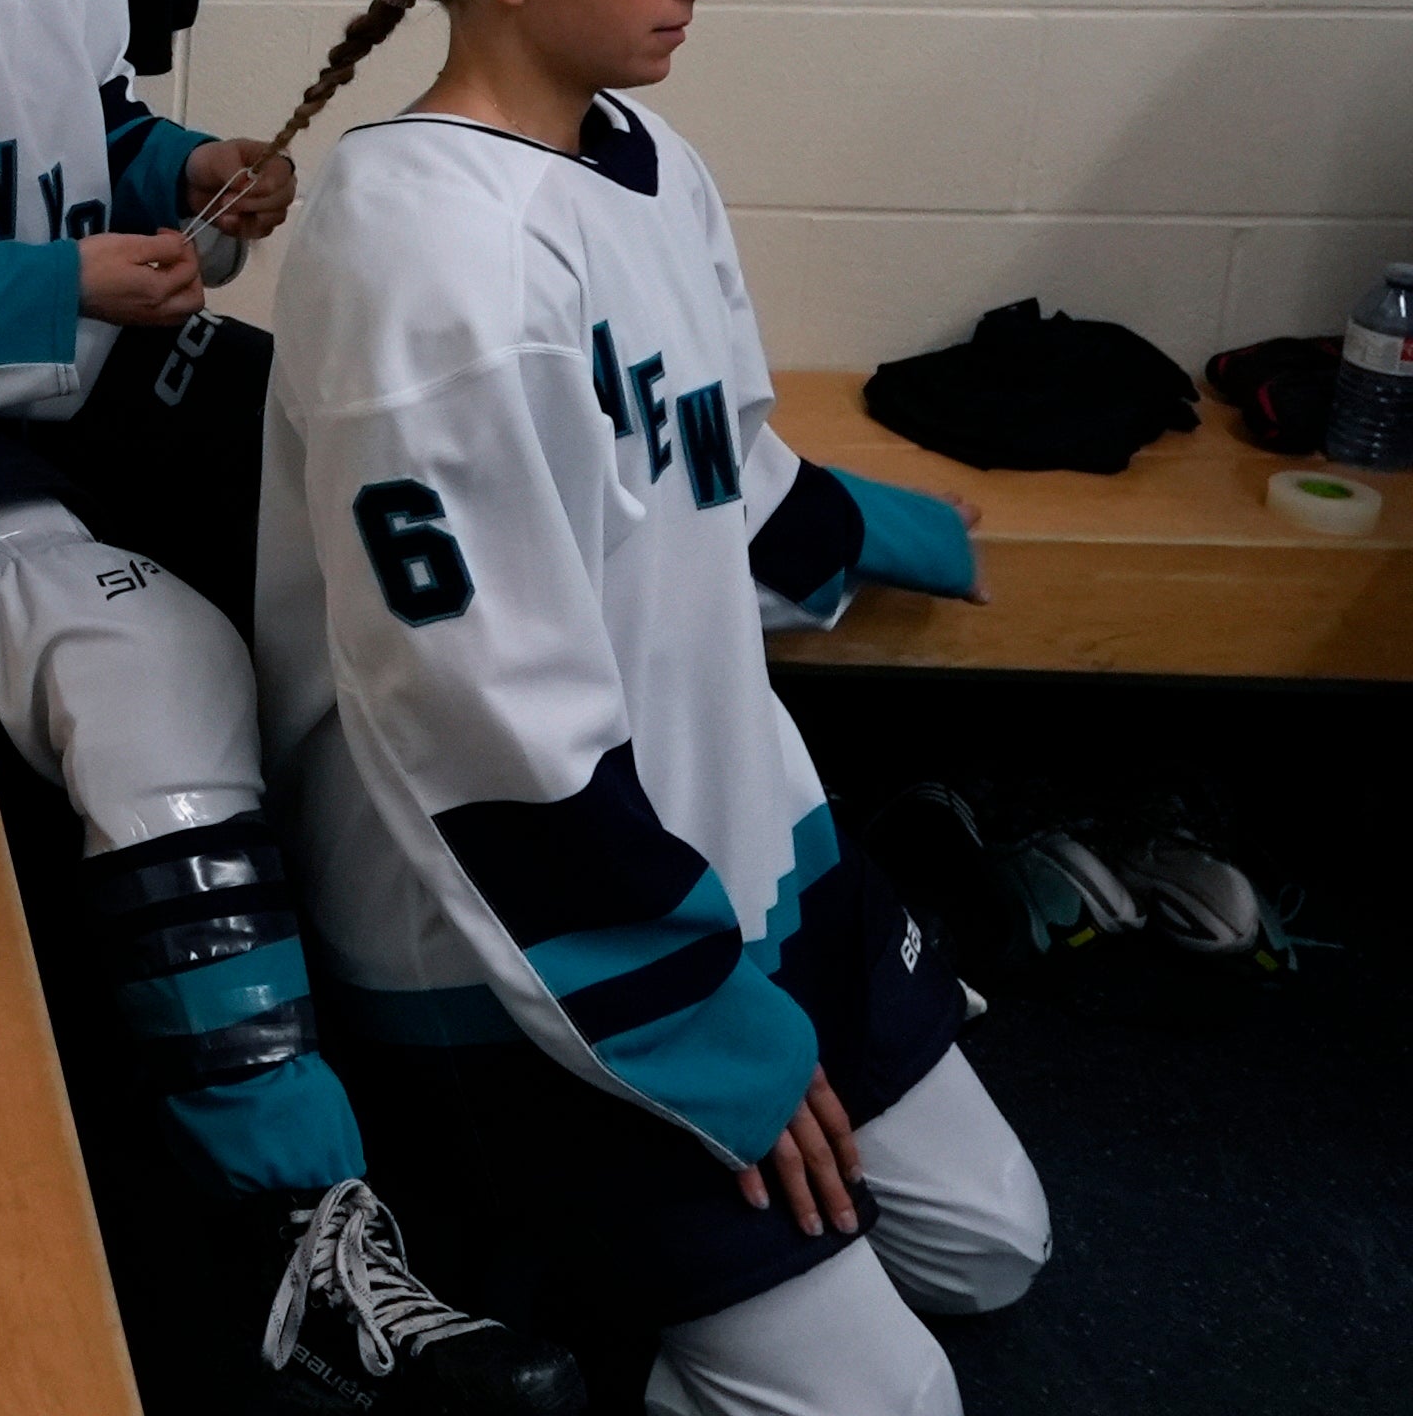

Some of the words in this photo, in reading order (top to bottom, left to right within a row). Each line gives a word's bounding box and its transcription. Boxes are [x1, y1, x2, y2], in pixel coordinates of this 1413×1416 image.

[154, 308, 223, 407] CC
[592, 319, 742, 509] NEW
[352, 478, 475, 628] 6
